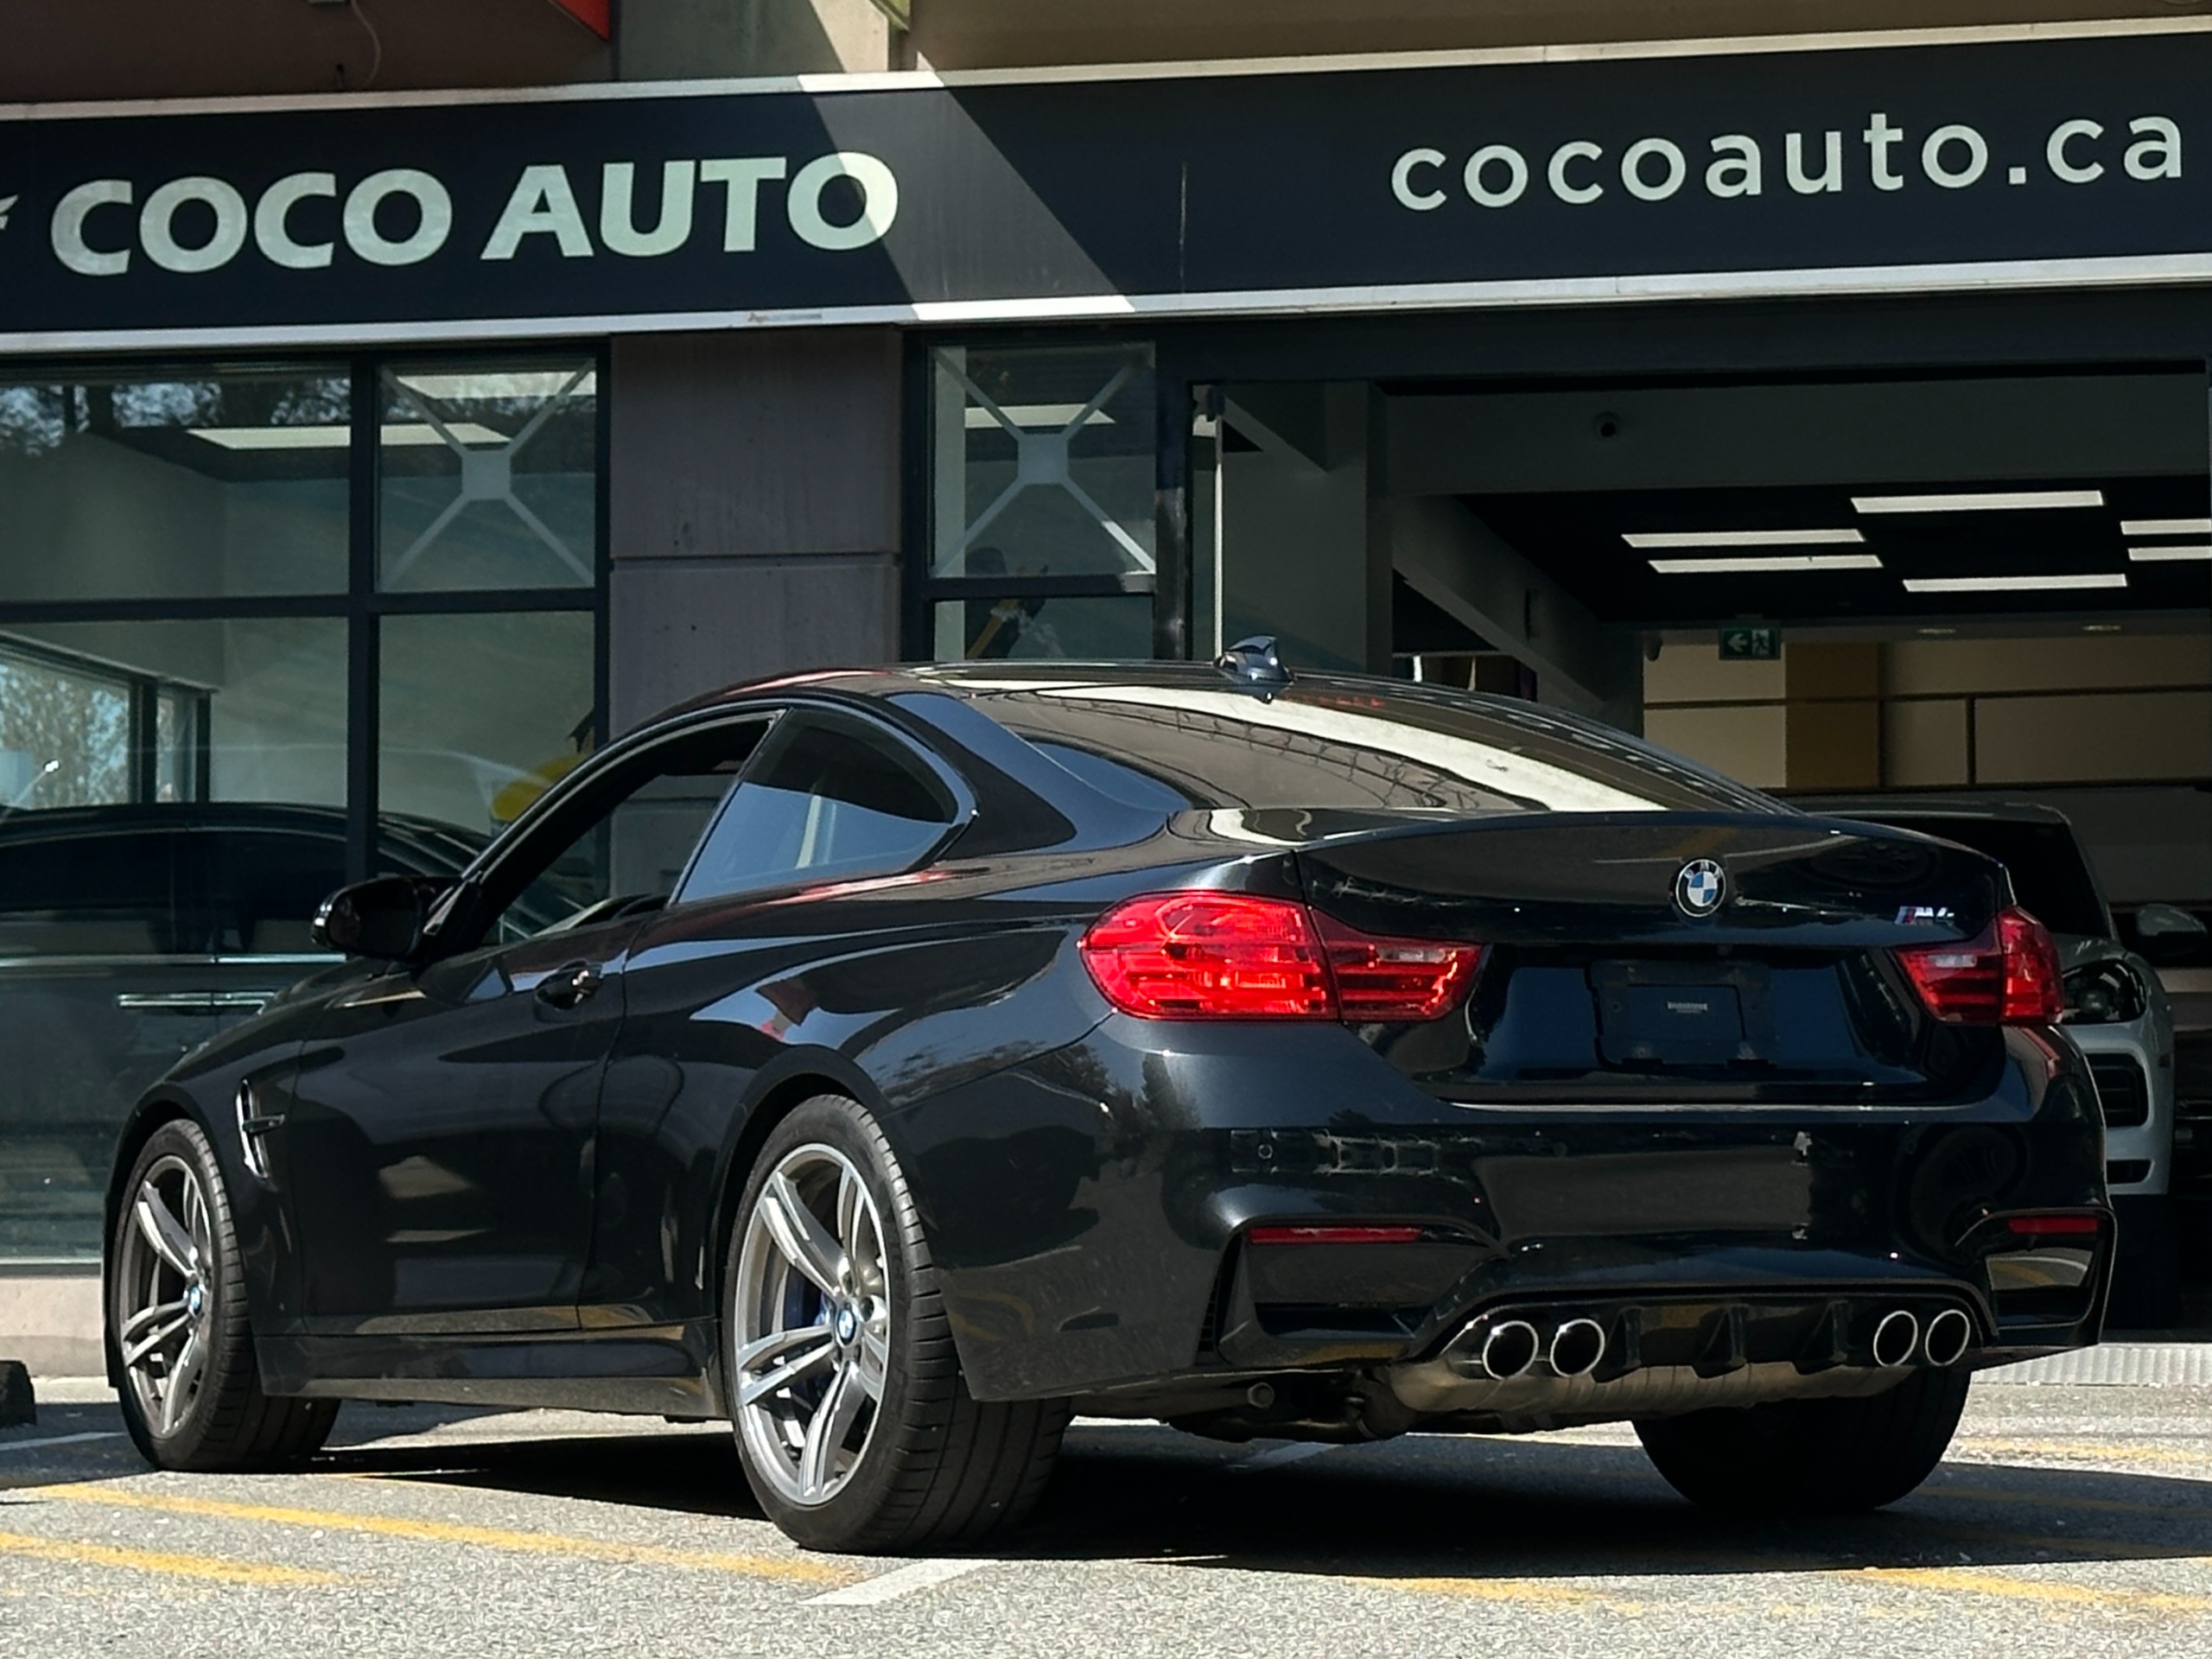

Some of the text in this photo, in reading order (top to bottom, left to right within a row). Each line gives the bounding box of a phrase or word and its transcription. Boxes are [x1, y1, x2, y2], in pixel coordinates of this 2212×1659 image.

[52, 151, 899, 276] COCO AUTO
[1391, 113, 2182, 211] cocoauto.ca
